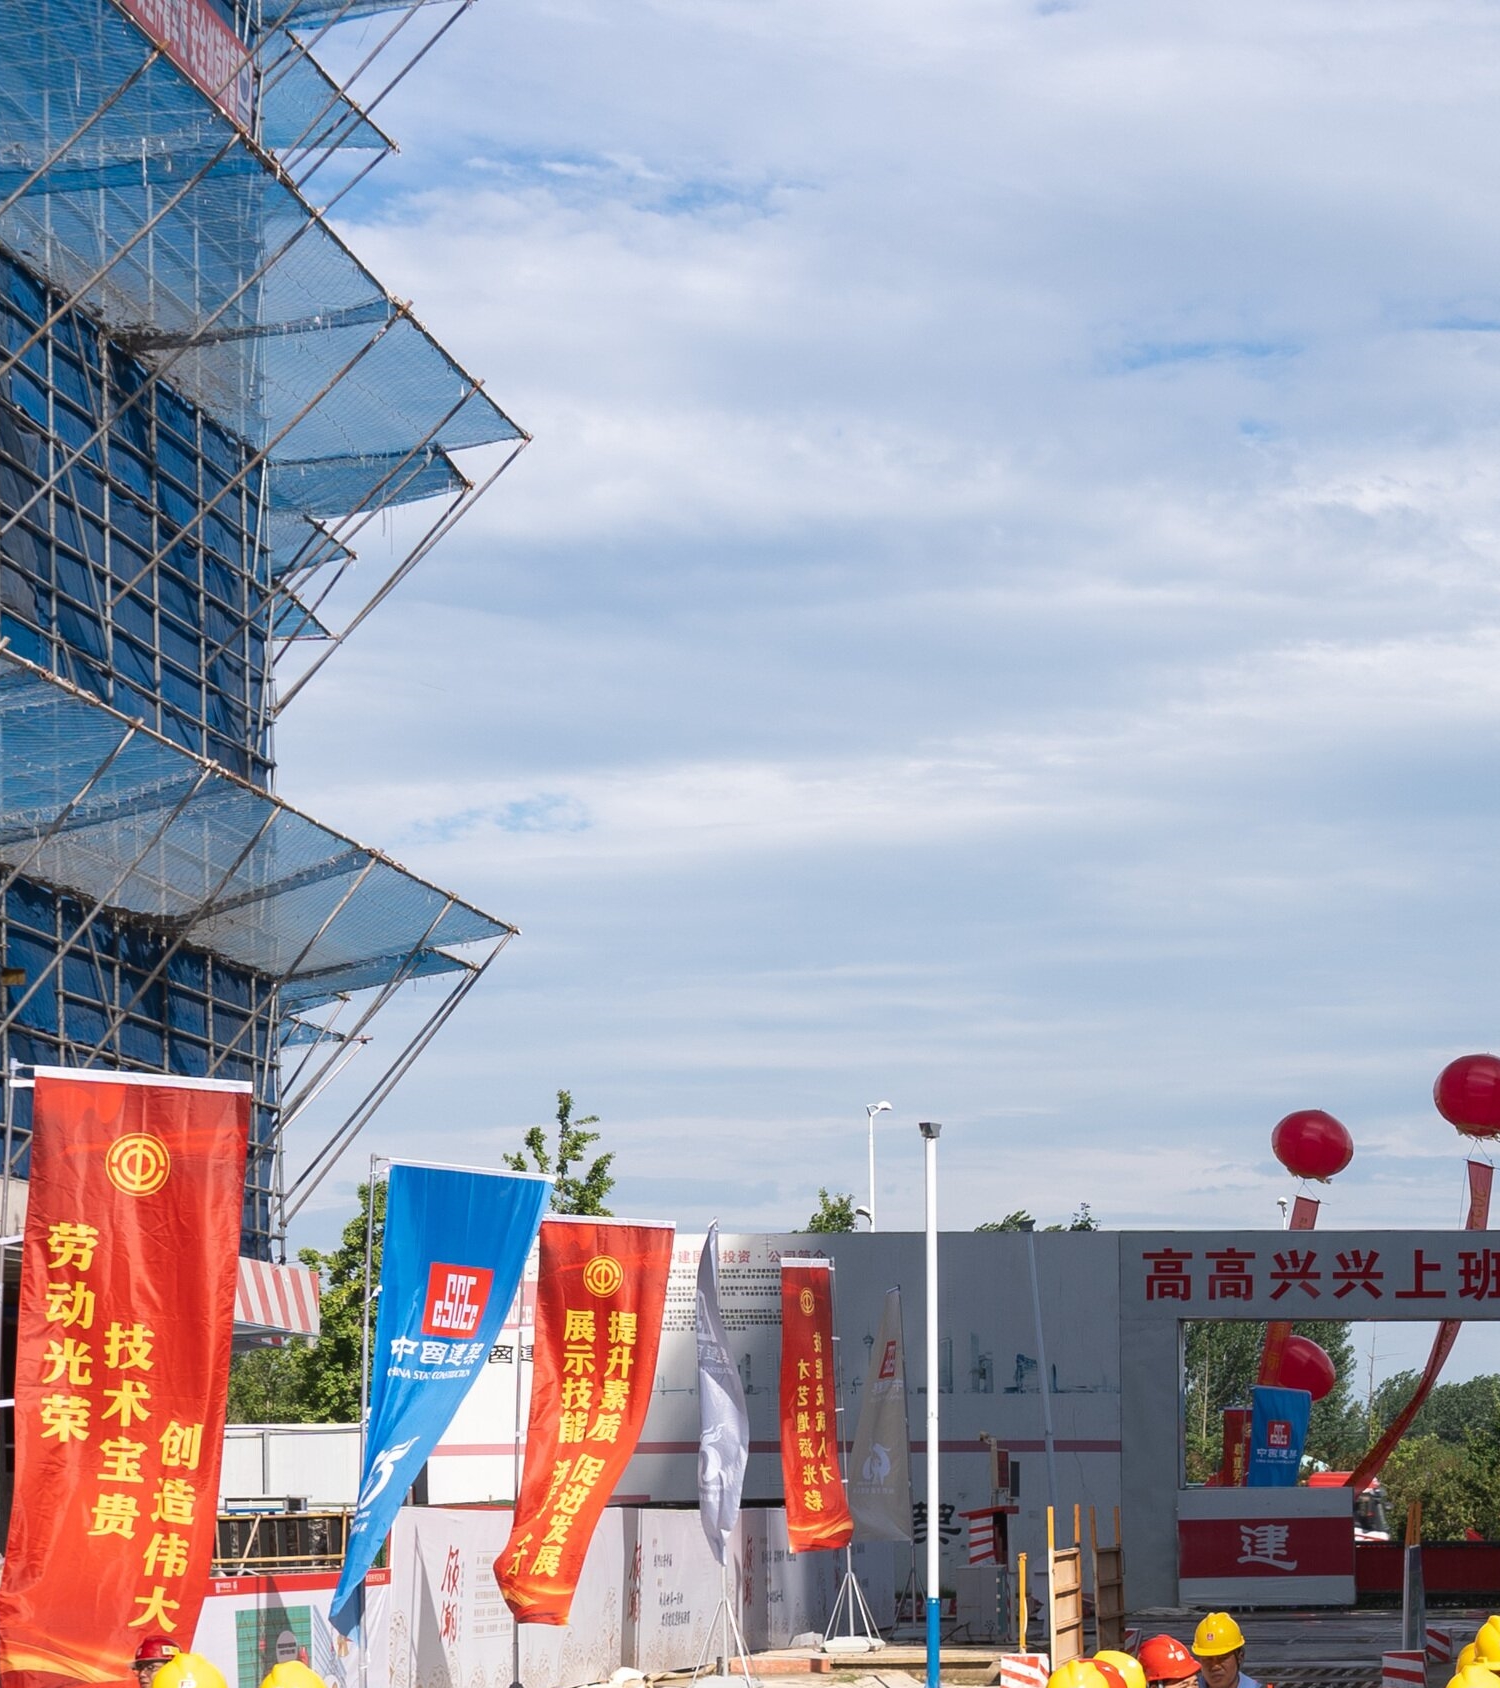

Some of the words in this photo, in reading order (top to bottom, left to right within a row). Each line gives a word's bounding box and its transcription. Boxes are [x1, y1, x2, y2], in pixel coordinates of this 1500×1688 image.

[39, 1221, 100, 1444] 劳动光荣
[558, 1308, 597, 1444] 展示技能
[588, 1310, 638, 1444] 提升素质
[87, 1321, 156, 1541] 技术宝贵
[126, 1420, 205, 1634] 创造伟大
[529, 1452, 606, 1578] 促进发展
[1236, 1522, 1298, 1571] 建
